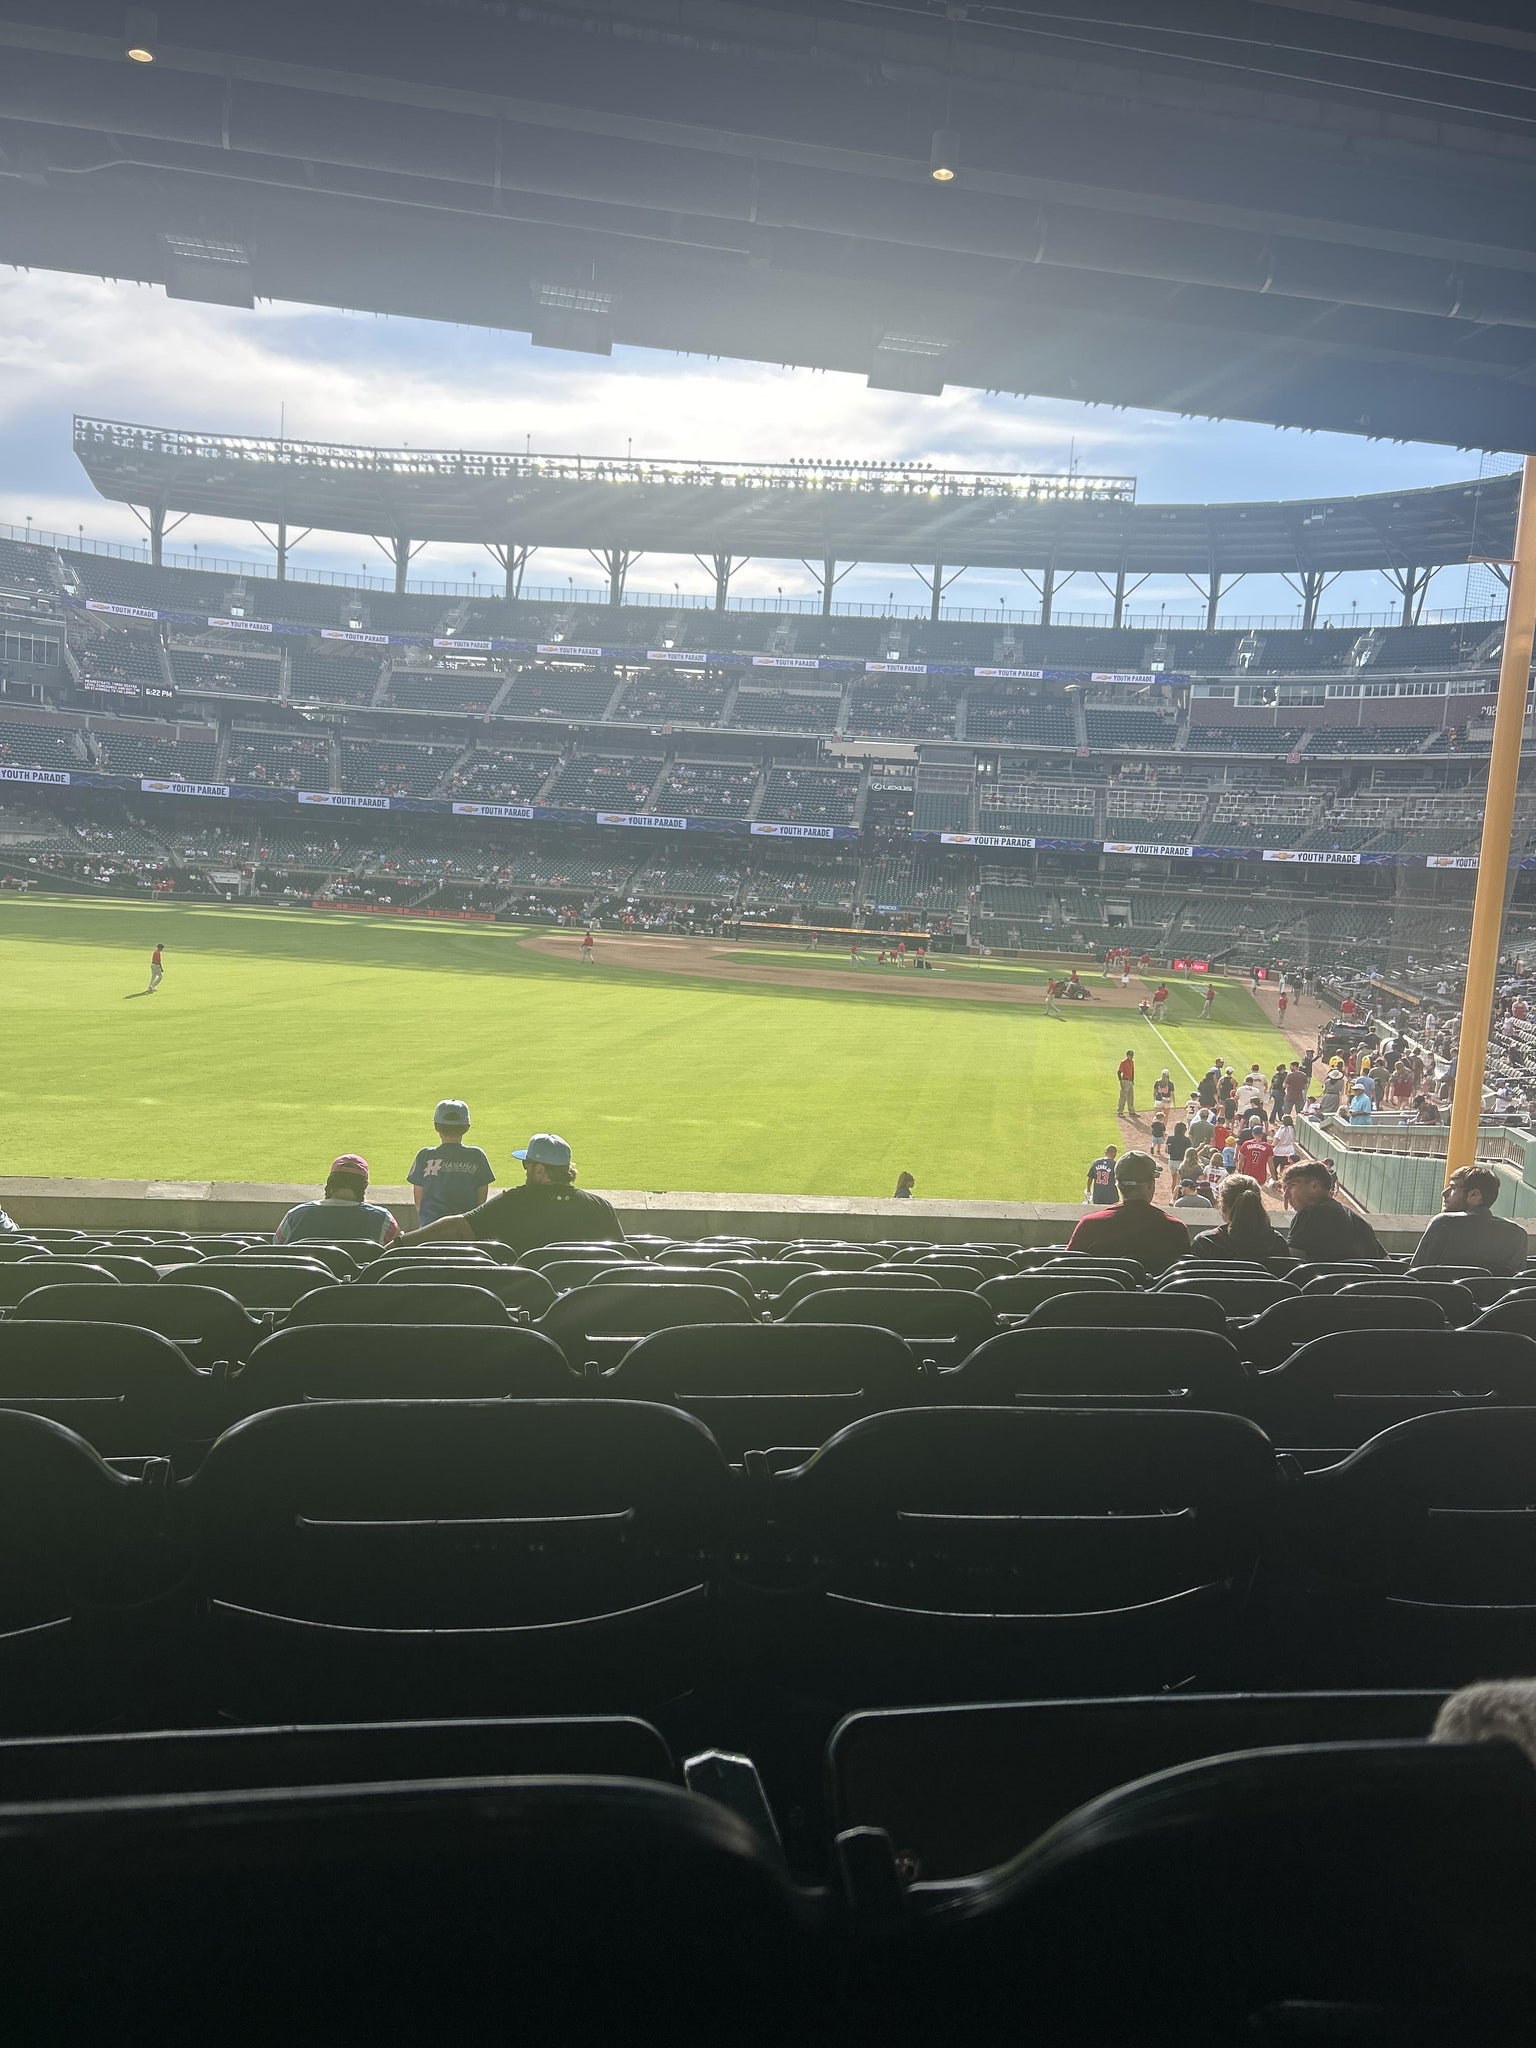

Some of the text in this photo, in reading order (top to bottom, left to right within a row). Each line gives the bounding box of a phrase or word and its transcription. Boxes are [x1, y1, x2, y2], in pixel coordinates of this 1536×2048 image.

[132, 609, 155, 618] PARADE
[146, 688, 160, 696] 6:22
[1, 770, 66, 782] YOUTH PARADE
[172, 785, 226, 796] YOUTH PARADE
[332, 797, 387, 807] YOUTH PARADE
[504, 808, 530, 817] PARADE
[628, 817, 683, 827] YOUTH PARADE
[974, 837, 1032, 847] YOUTH PARADE
[1160, 846, 1189, 855] PARADE
[1298, 853, 1357, 863] YOUTH PARADE
[1456, 857, 1477, 867] YOUTH
[1189, 1106, 1195, 1114] 3
[1252, 1151, 1261, 1163] 7
[423, 1159, 442, 1177] H
[1096, 1170, 1109, 1185] 13
